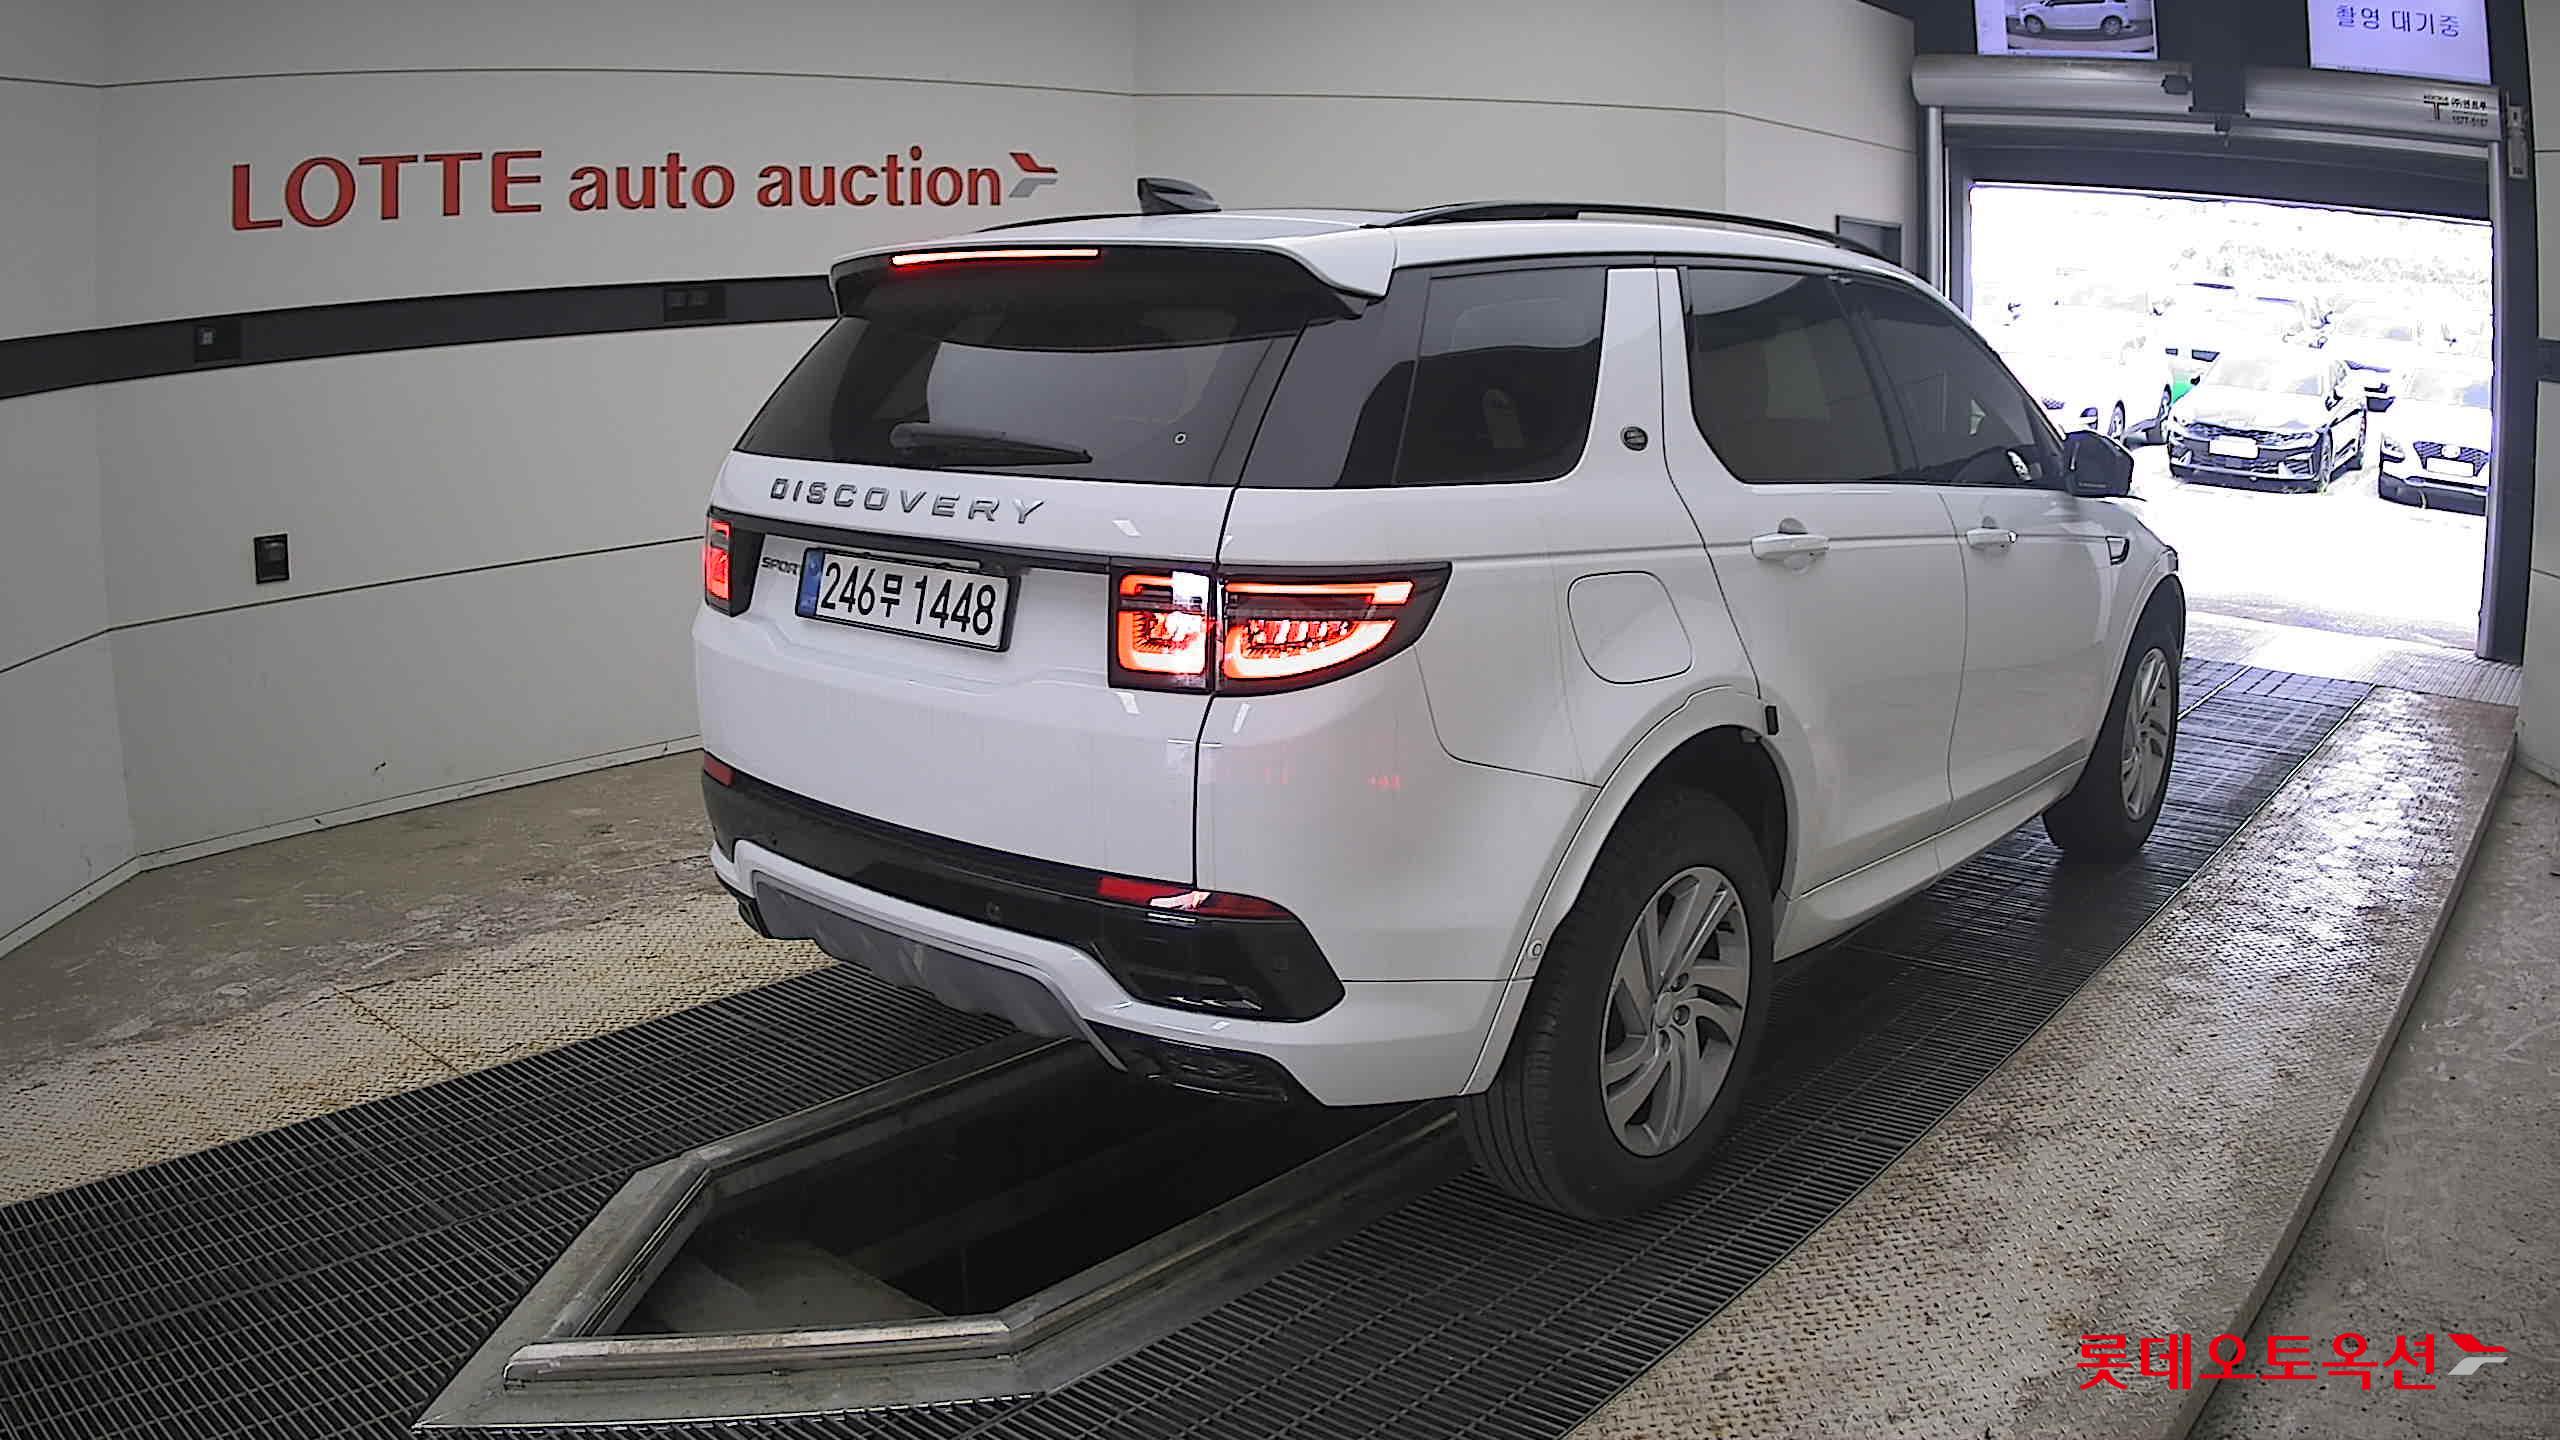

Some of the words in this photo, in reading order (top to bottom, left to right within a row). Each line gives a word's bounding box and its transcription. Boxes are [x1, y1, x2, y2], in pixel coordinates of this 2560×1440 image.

[2336, 4, 2379, 30] 촬영
[2391, 10, 2459, 38] 대기중
[232, 150, 542, 231] LOTTE
[568, 151, 736, 211] auto
[756, 144, 1001, 208] auction
[769, 477, 1045, 525] DISCOVERY
[761, 556, 800, 576] SPOR
[820, 561, 904, 618] 246무
[914, 574, 997, 636] 1448
